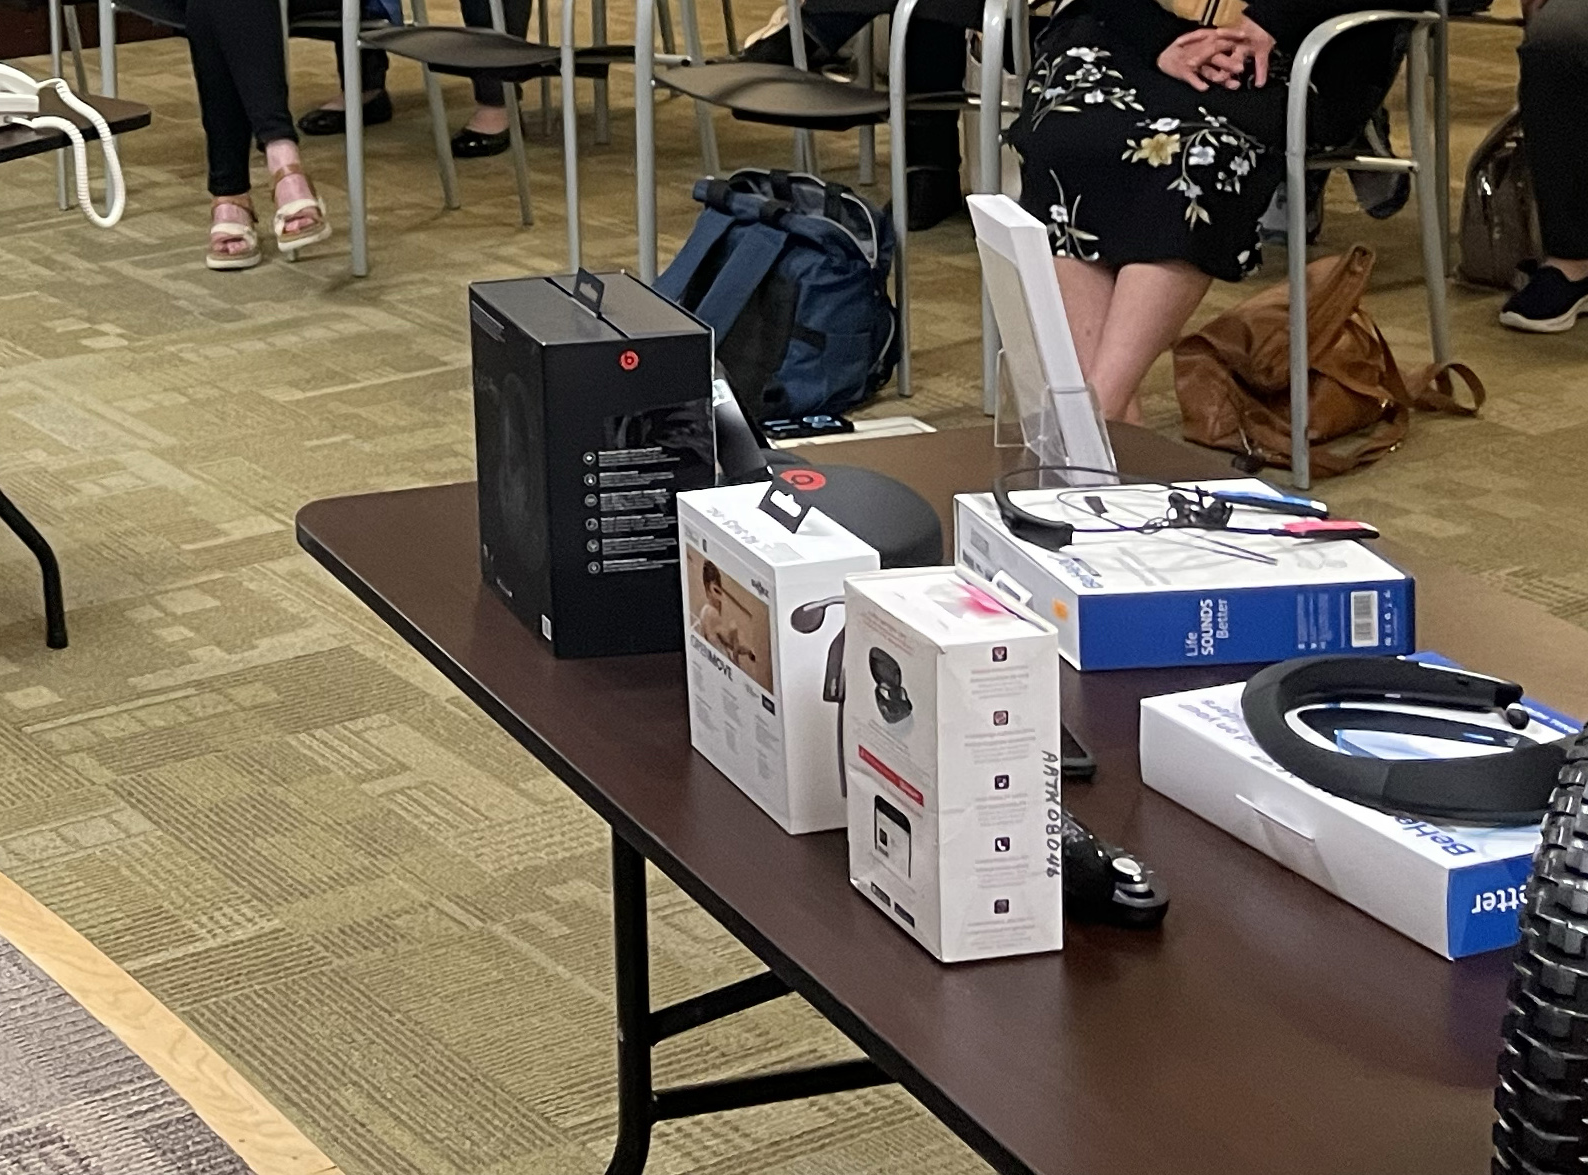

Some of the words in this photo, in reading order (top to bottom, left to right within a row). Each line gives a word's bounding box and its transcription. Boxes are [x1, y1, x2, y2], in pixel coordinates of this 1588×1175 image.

[1200, 598, 1214, 656] SOUNDS
[1216, 598, 1229, 639] Better
[1185, 631, 1199, 657] Life
[1394, 815, 1476, 856] BeHe
[1471, 884, 1528, 915] etter
